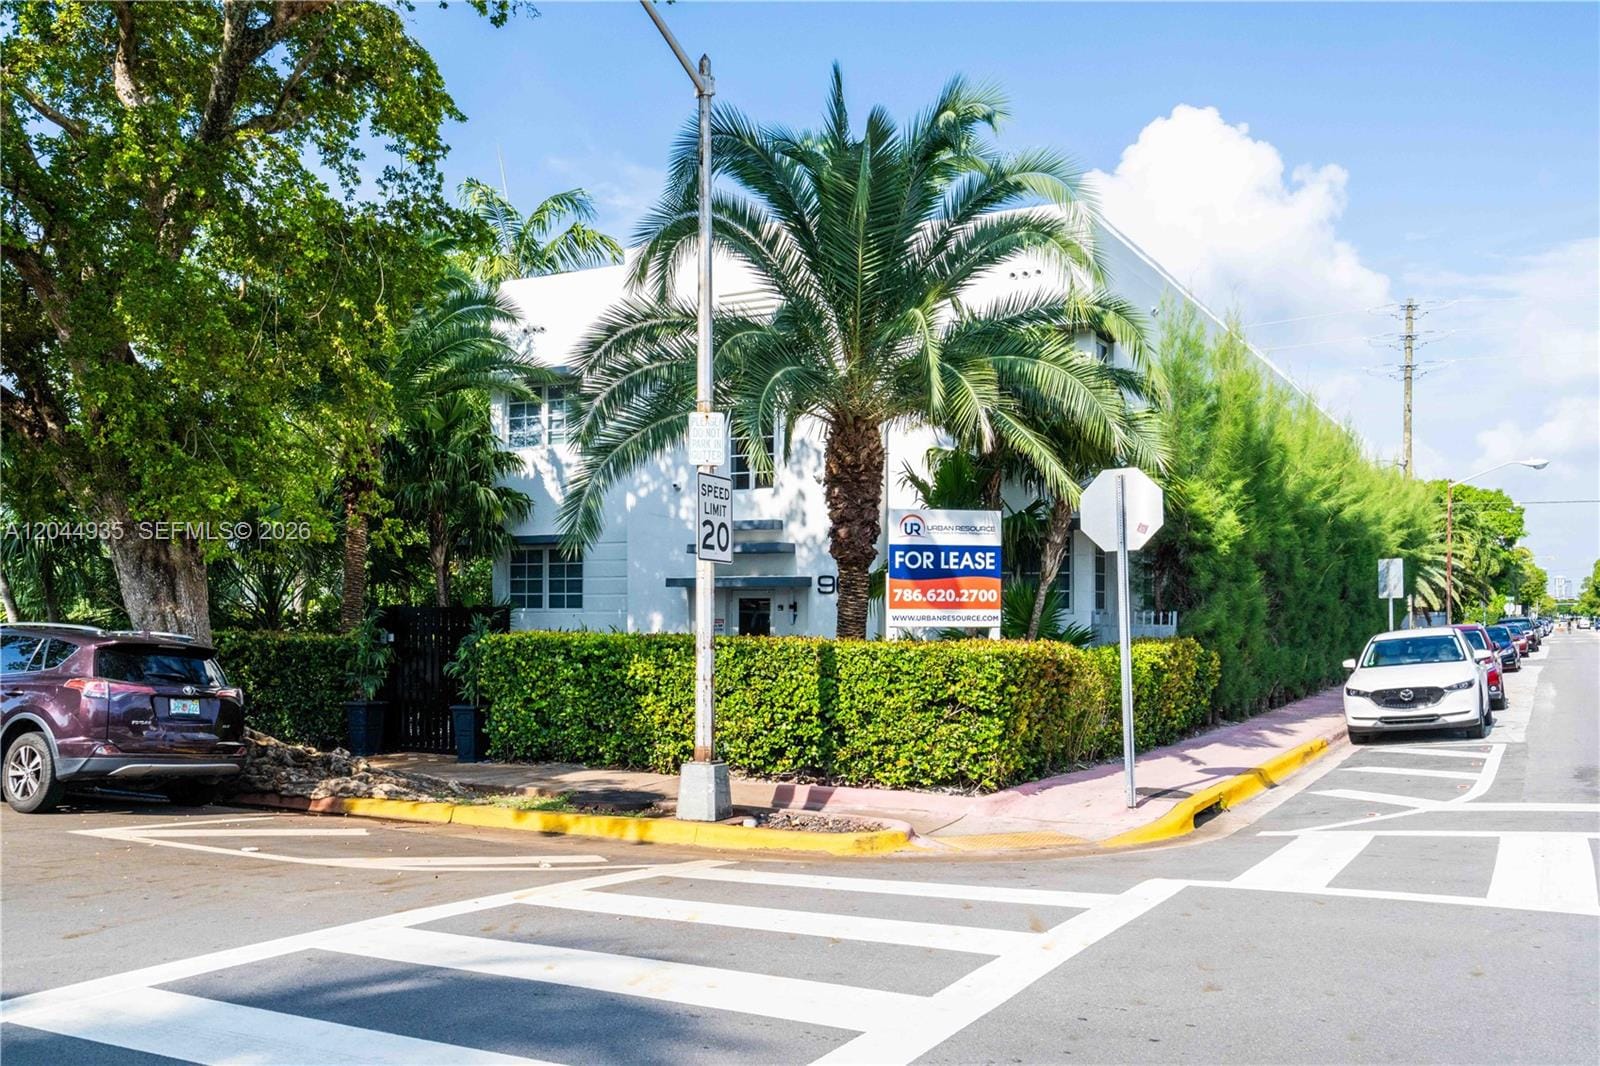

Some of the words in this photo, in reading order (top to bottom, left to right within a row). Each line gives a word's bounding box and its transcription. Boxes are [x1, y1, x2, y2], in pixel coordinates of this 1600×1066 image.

[706, 428, 720, 438] NOT
[692, 439, 711, 449] PARK
[714, 439, 722, 449] IN
[701, 483, 730, 501] SPEED
[704, 501, 727, 517] LIMIT
[702, 519, 729, 552] 20
[904, 523, 921, 536] UR
[895, 551, 934, 569] FOR
[941, 552, 995, 569] LEASE
[817, 575, 839, 594] 9
[893, 588, 998, 602] 786.620.2700
[892, 614, 999, 622] WWW.URBANRESOURCE.COM
